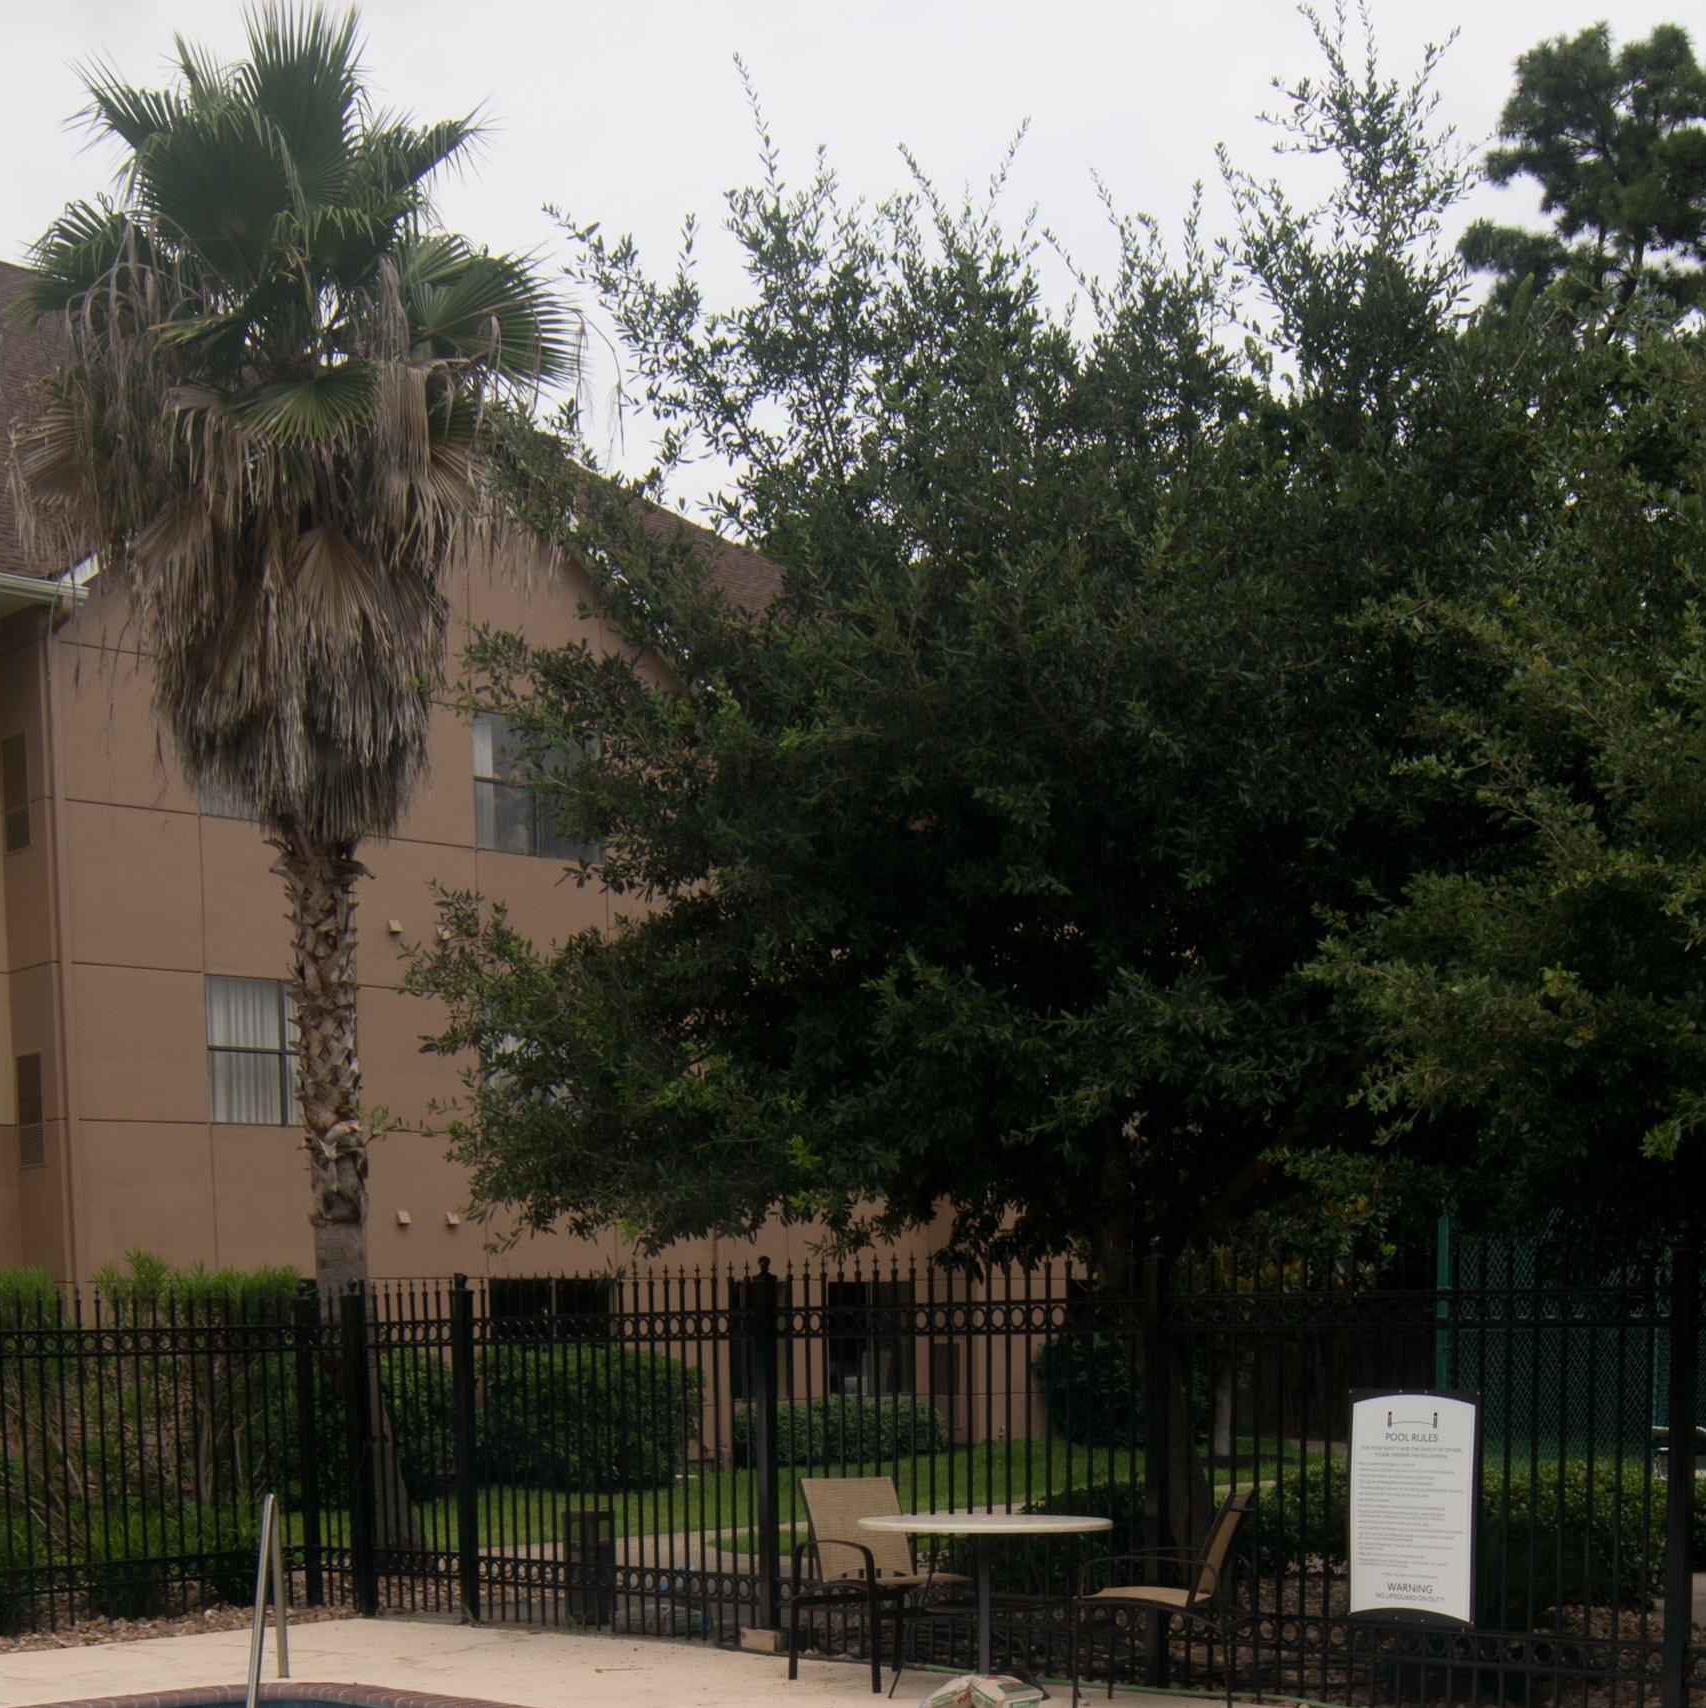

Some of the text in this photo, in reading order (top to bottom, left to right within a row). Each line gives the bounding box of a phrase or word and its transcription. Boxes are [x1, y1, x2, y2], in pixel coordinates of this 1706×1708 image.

[1385, 1432, 1439, 1443] POOL RULES
[1388, 1582, 1433, 1594] WARNING
[1386, 1593, 1416, 1601] LIFEGUARD
